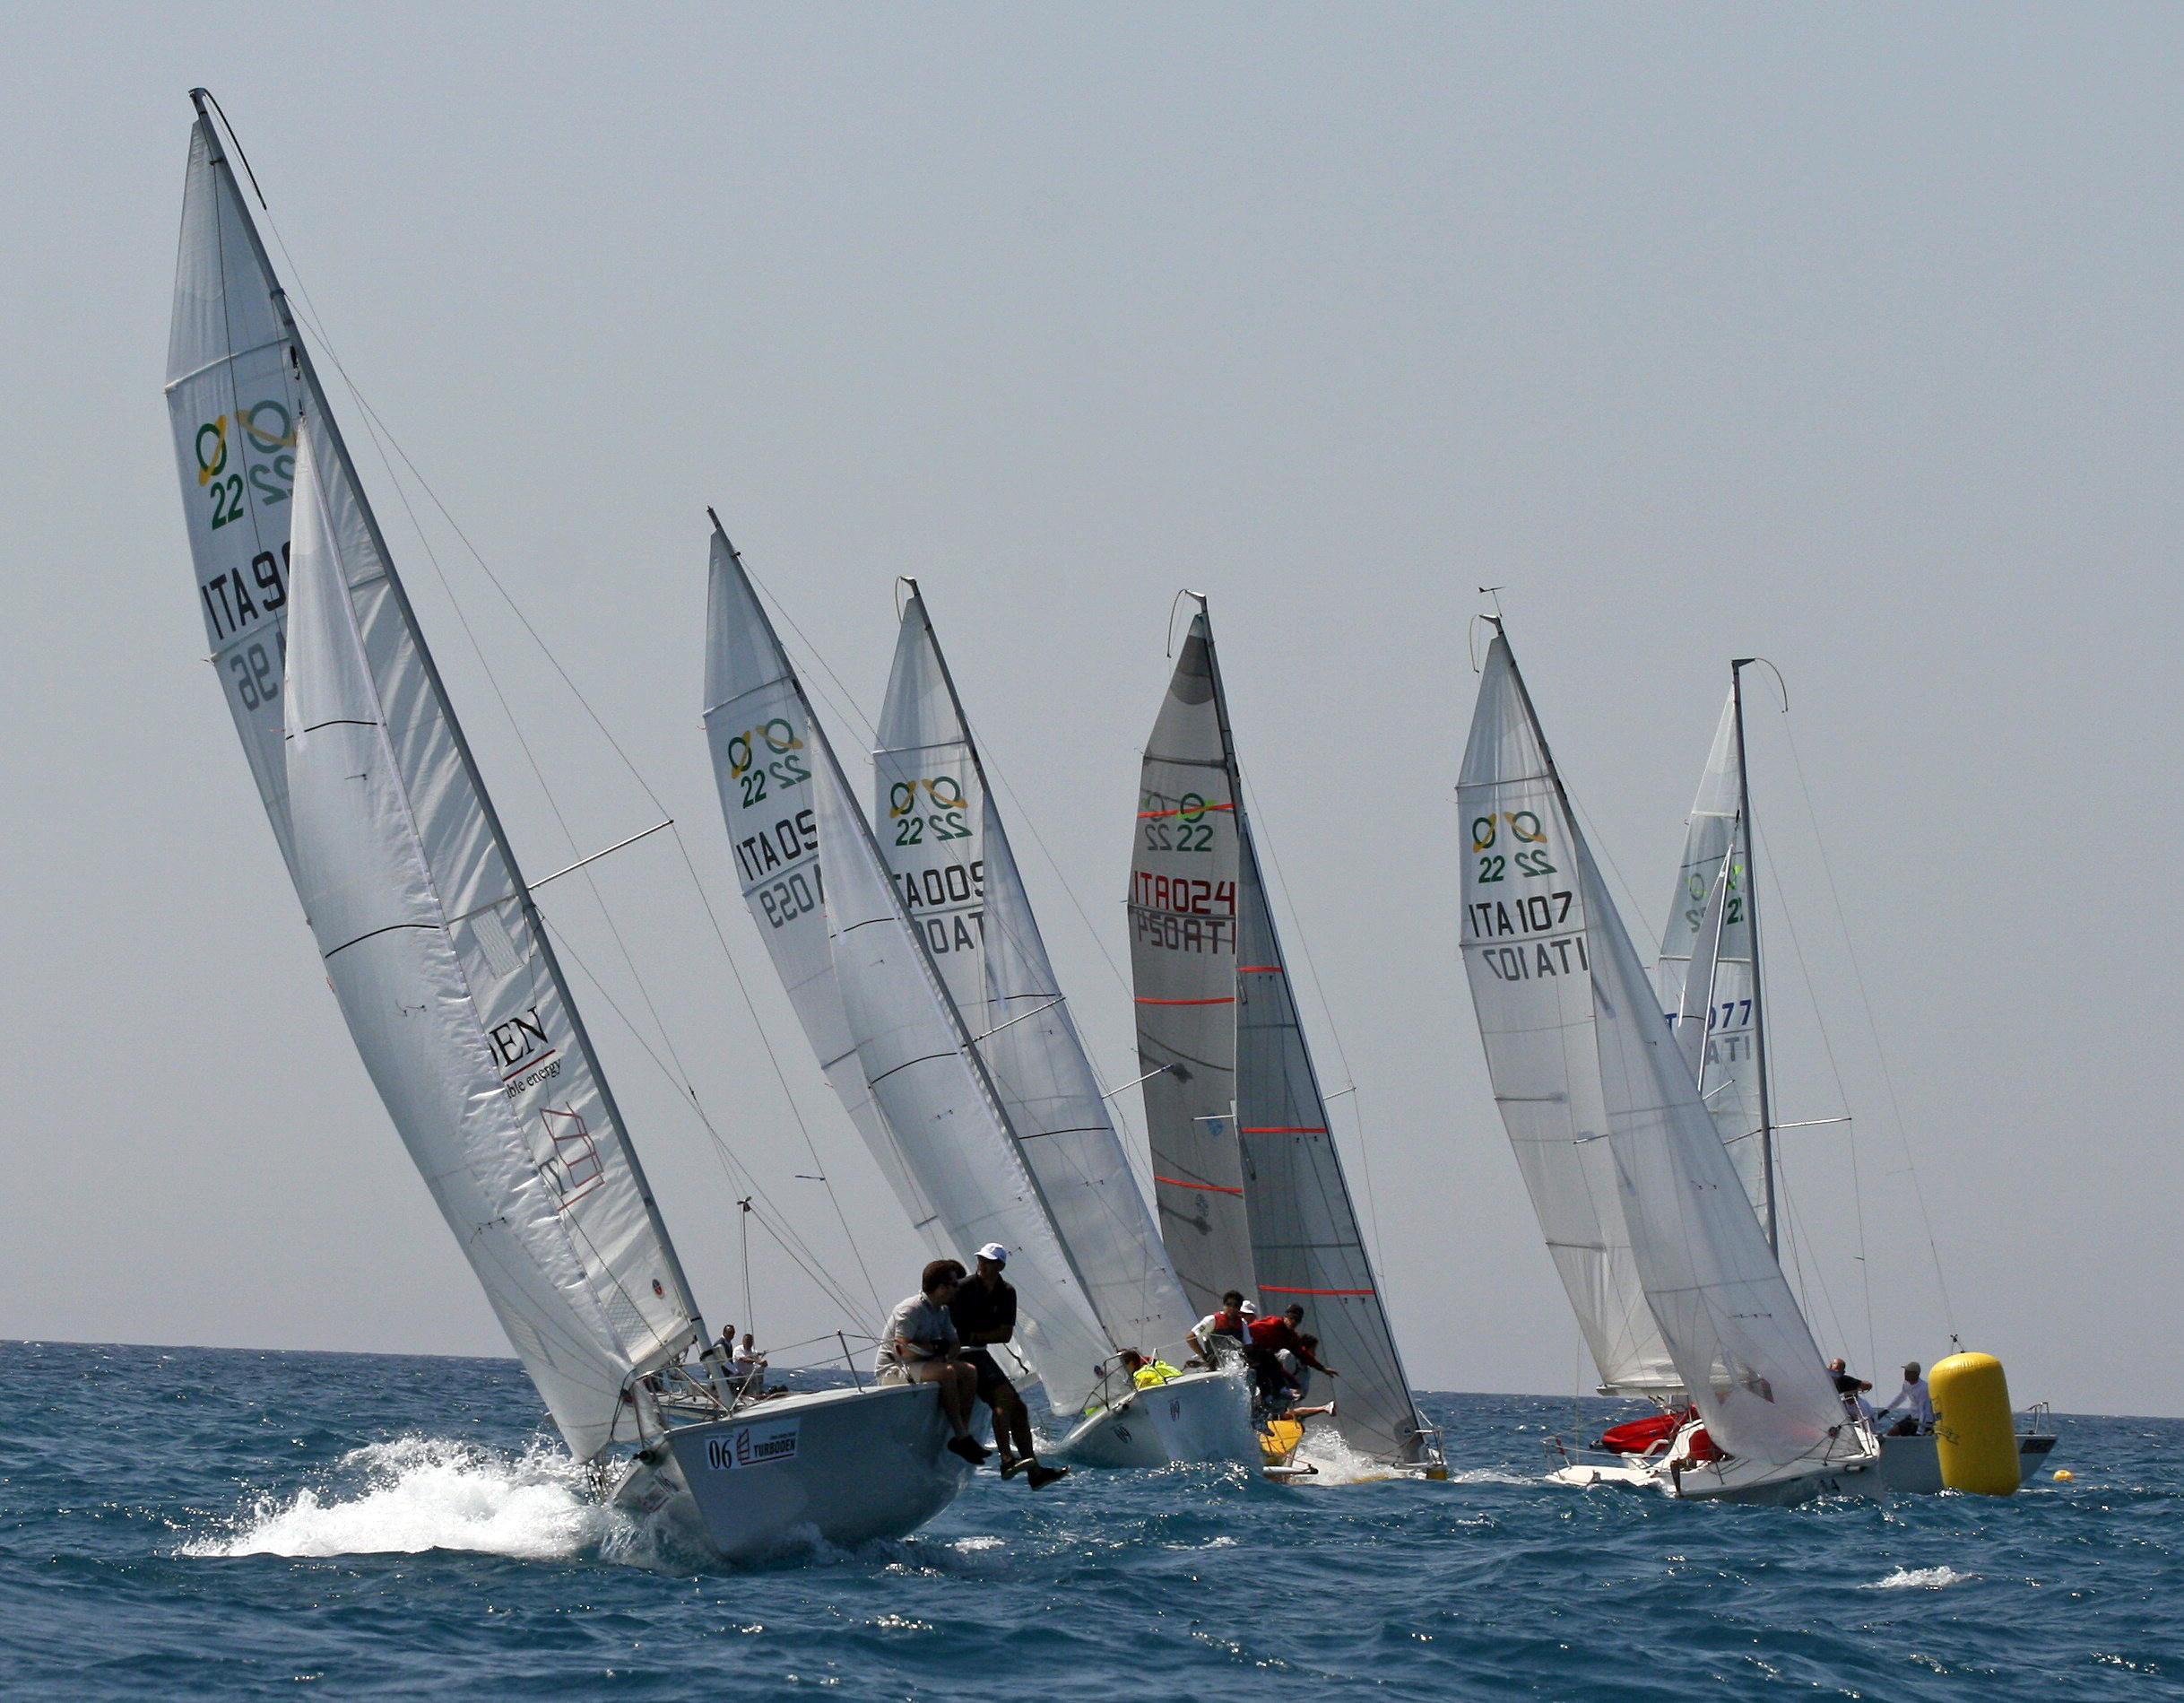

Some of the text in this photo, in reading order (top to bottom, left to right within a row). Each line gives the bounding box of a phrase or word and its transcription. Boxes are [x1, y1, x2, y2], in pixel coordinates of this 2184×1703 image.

[210, 474, 244, 530] 22
[202, 540, 290, 640] ITA9
[741, 770, 767, 809] 22
[896, 817, 923, 846] 22
[1177, 824, 1213, 852] 22
[1478, 856, 1505, 883] 22
[490, 1005, 549, 1067] EN
[527, 1058, 561, 1087] energy
[709, 1439, 732, 1469] 06
